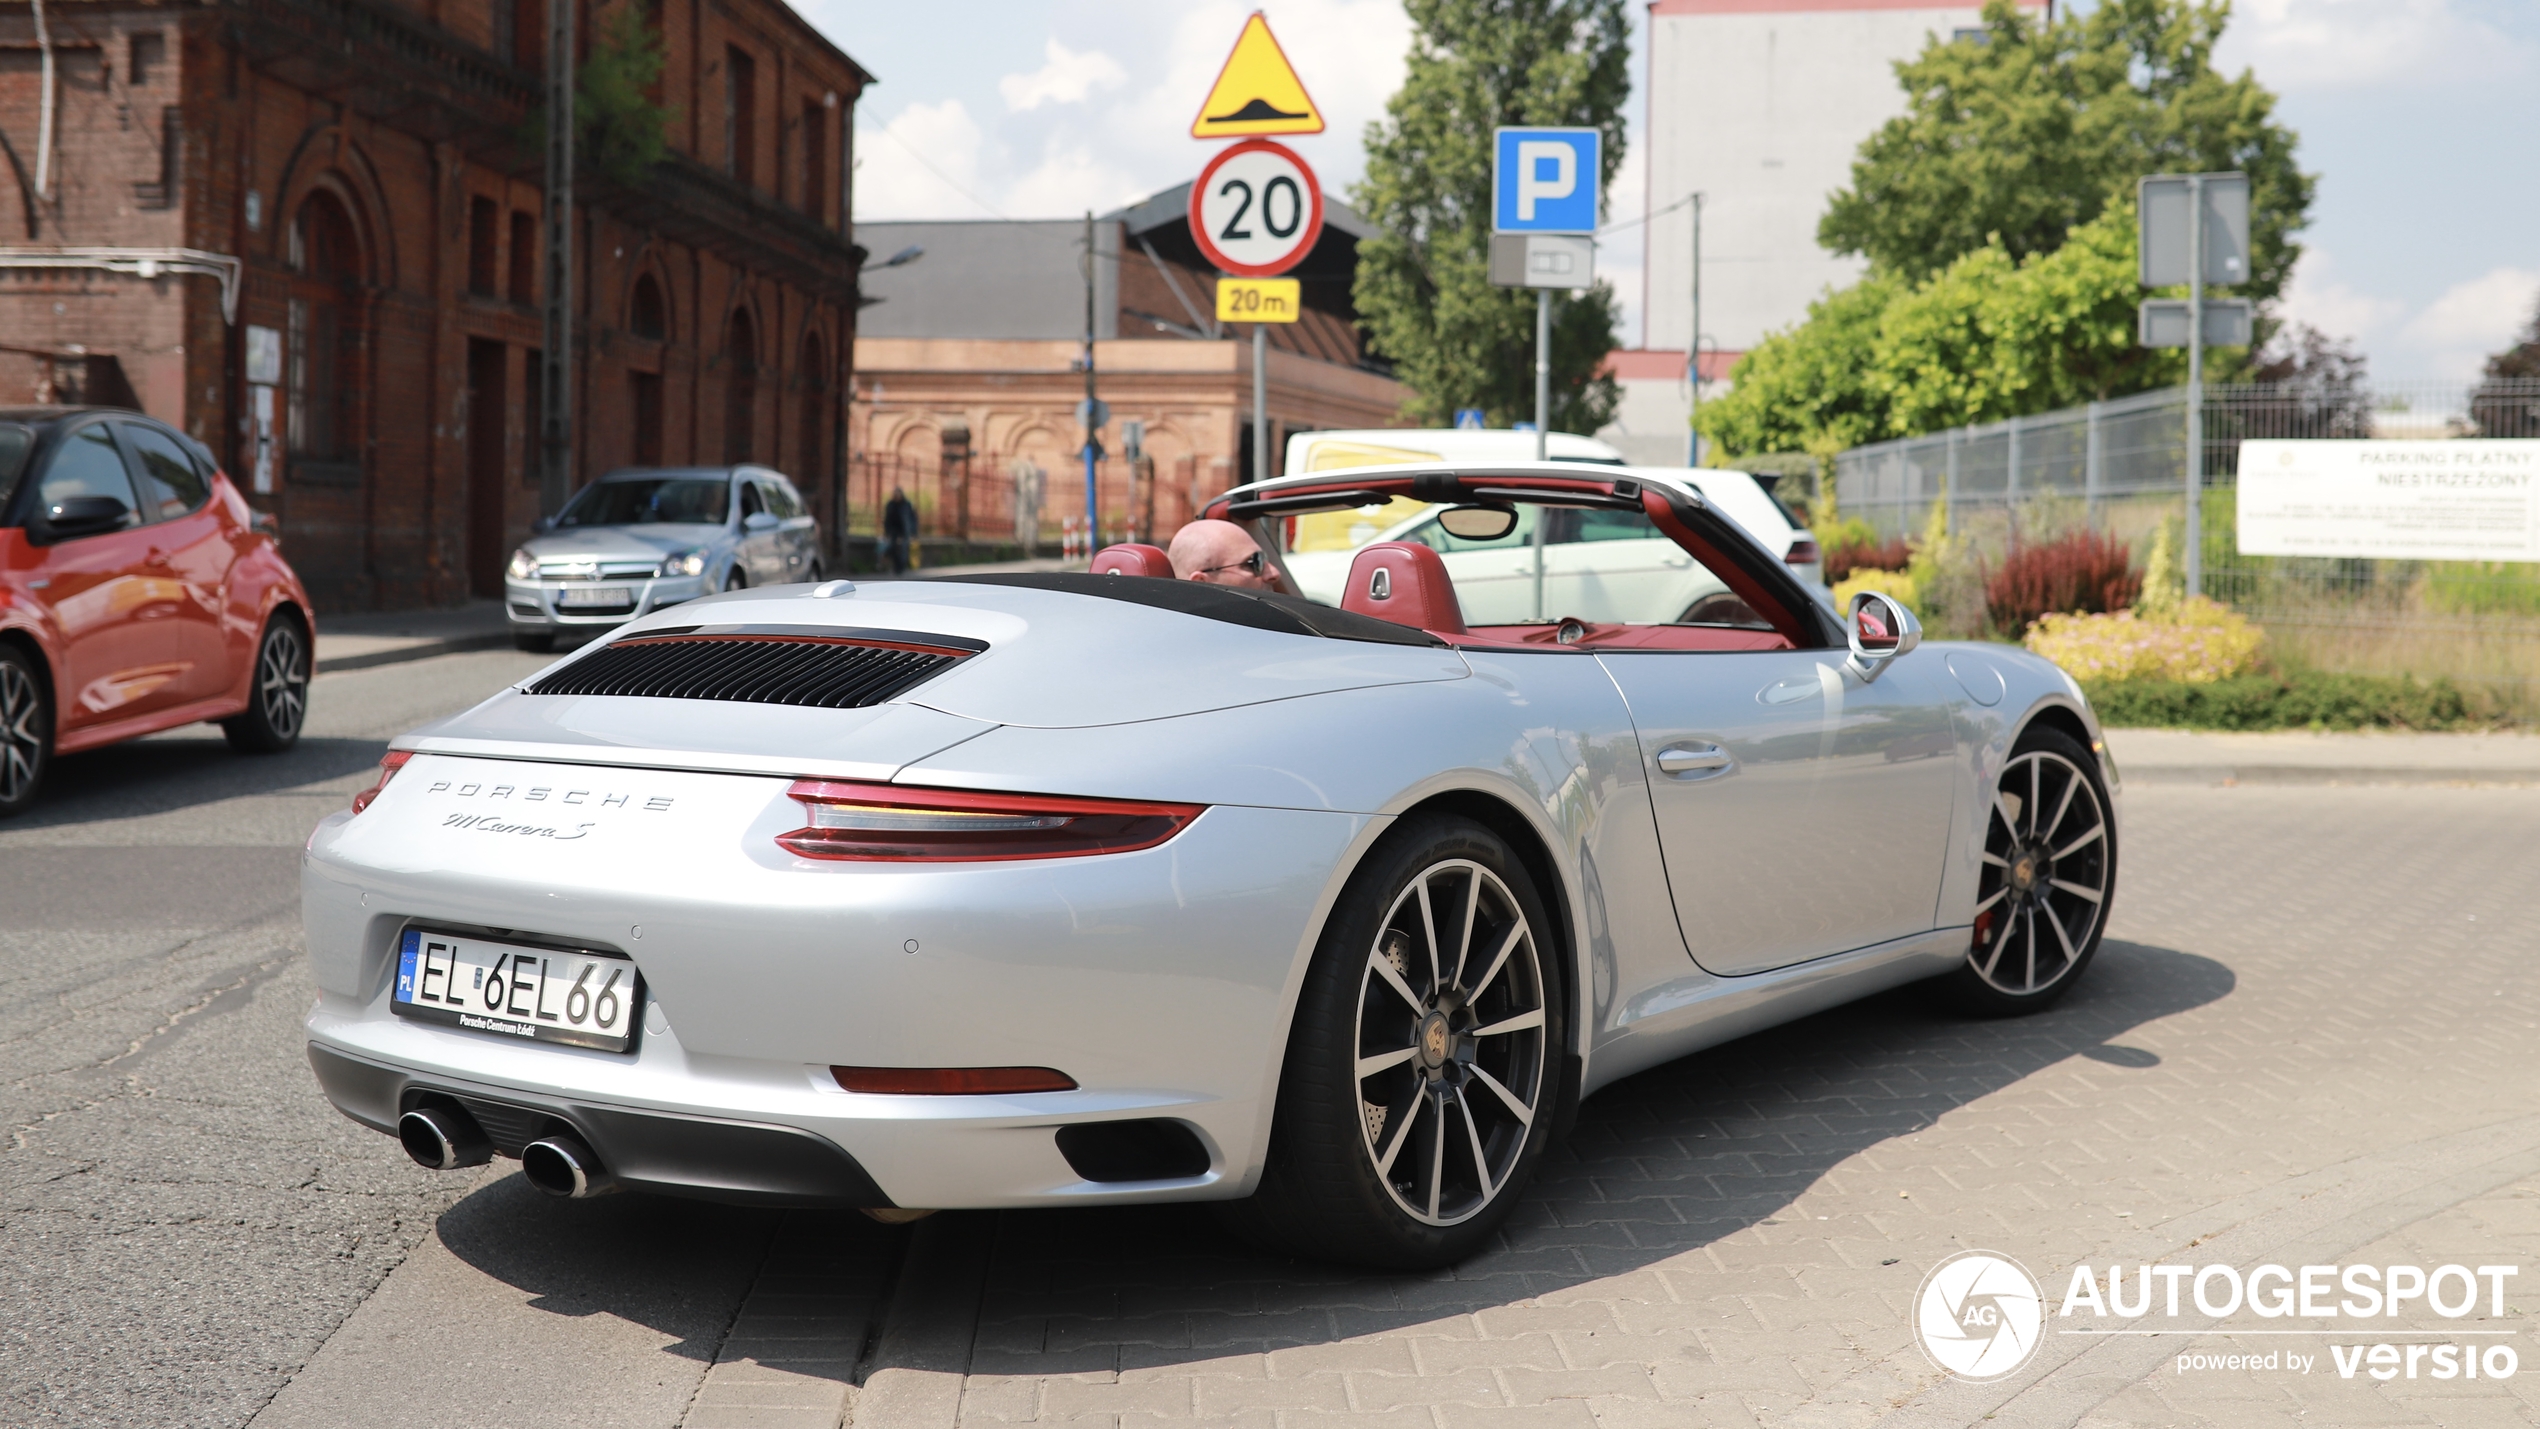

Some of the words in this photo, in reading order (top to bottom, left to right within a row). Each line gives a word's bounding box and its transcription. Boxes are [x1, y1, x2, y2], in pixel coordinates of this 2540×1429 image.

[1516, 140, 1577, 221] P
[1219, 176, 1302, 240] 20
[2360, 452, 2448, 466] PARKING
[427, 780, 674, 811] PORSCHE
[476, 816, 557, 838] Carrera
[554, 821, 596, 840] S
[399, 975, 413, 992] PL
[421, 942, 464, 1006] EL
[484, 953, 623, 1029] 6EL66
[459, 1014, 486, 1029] Porsche
[487, 1018, 517, 1034] Centrum
[516, 1023, 536, 1037] Łódź
